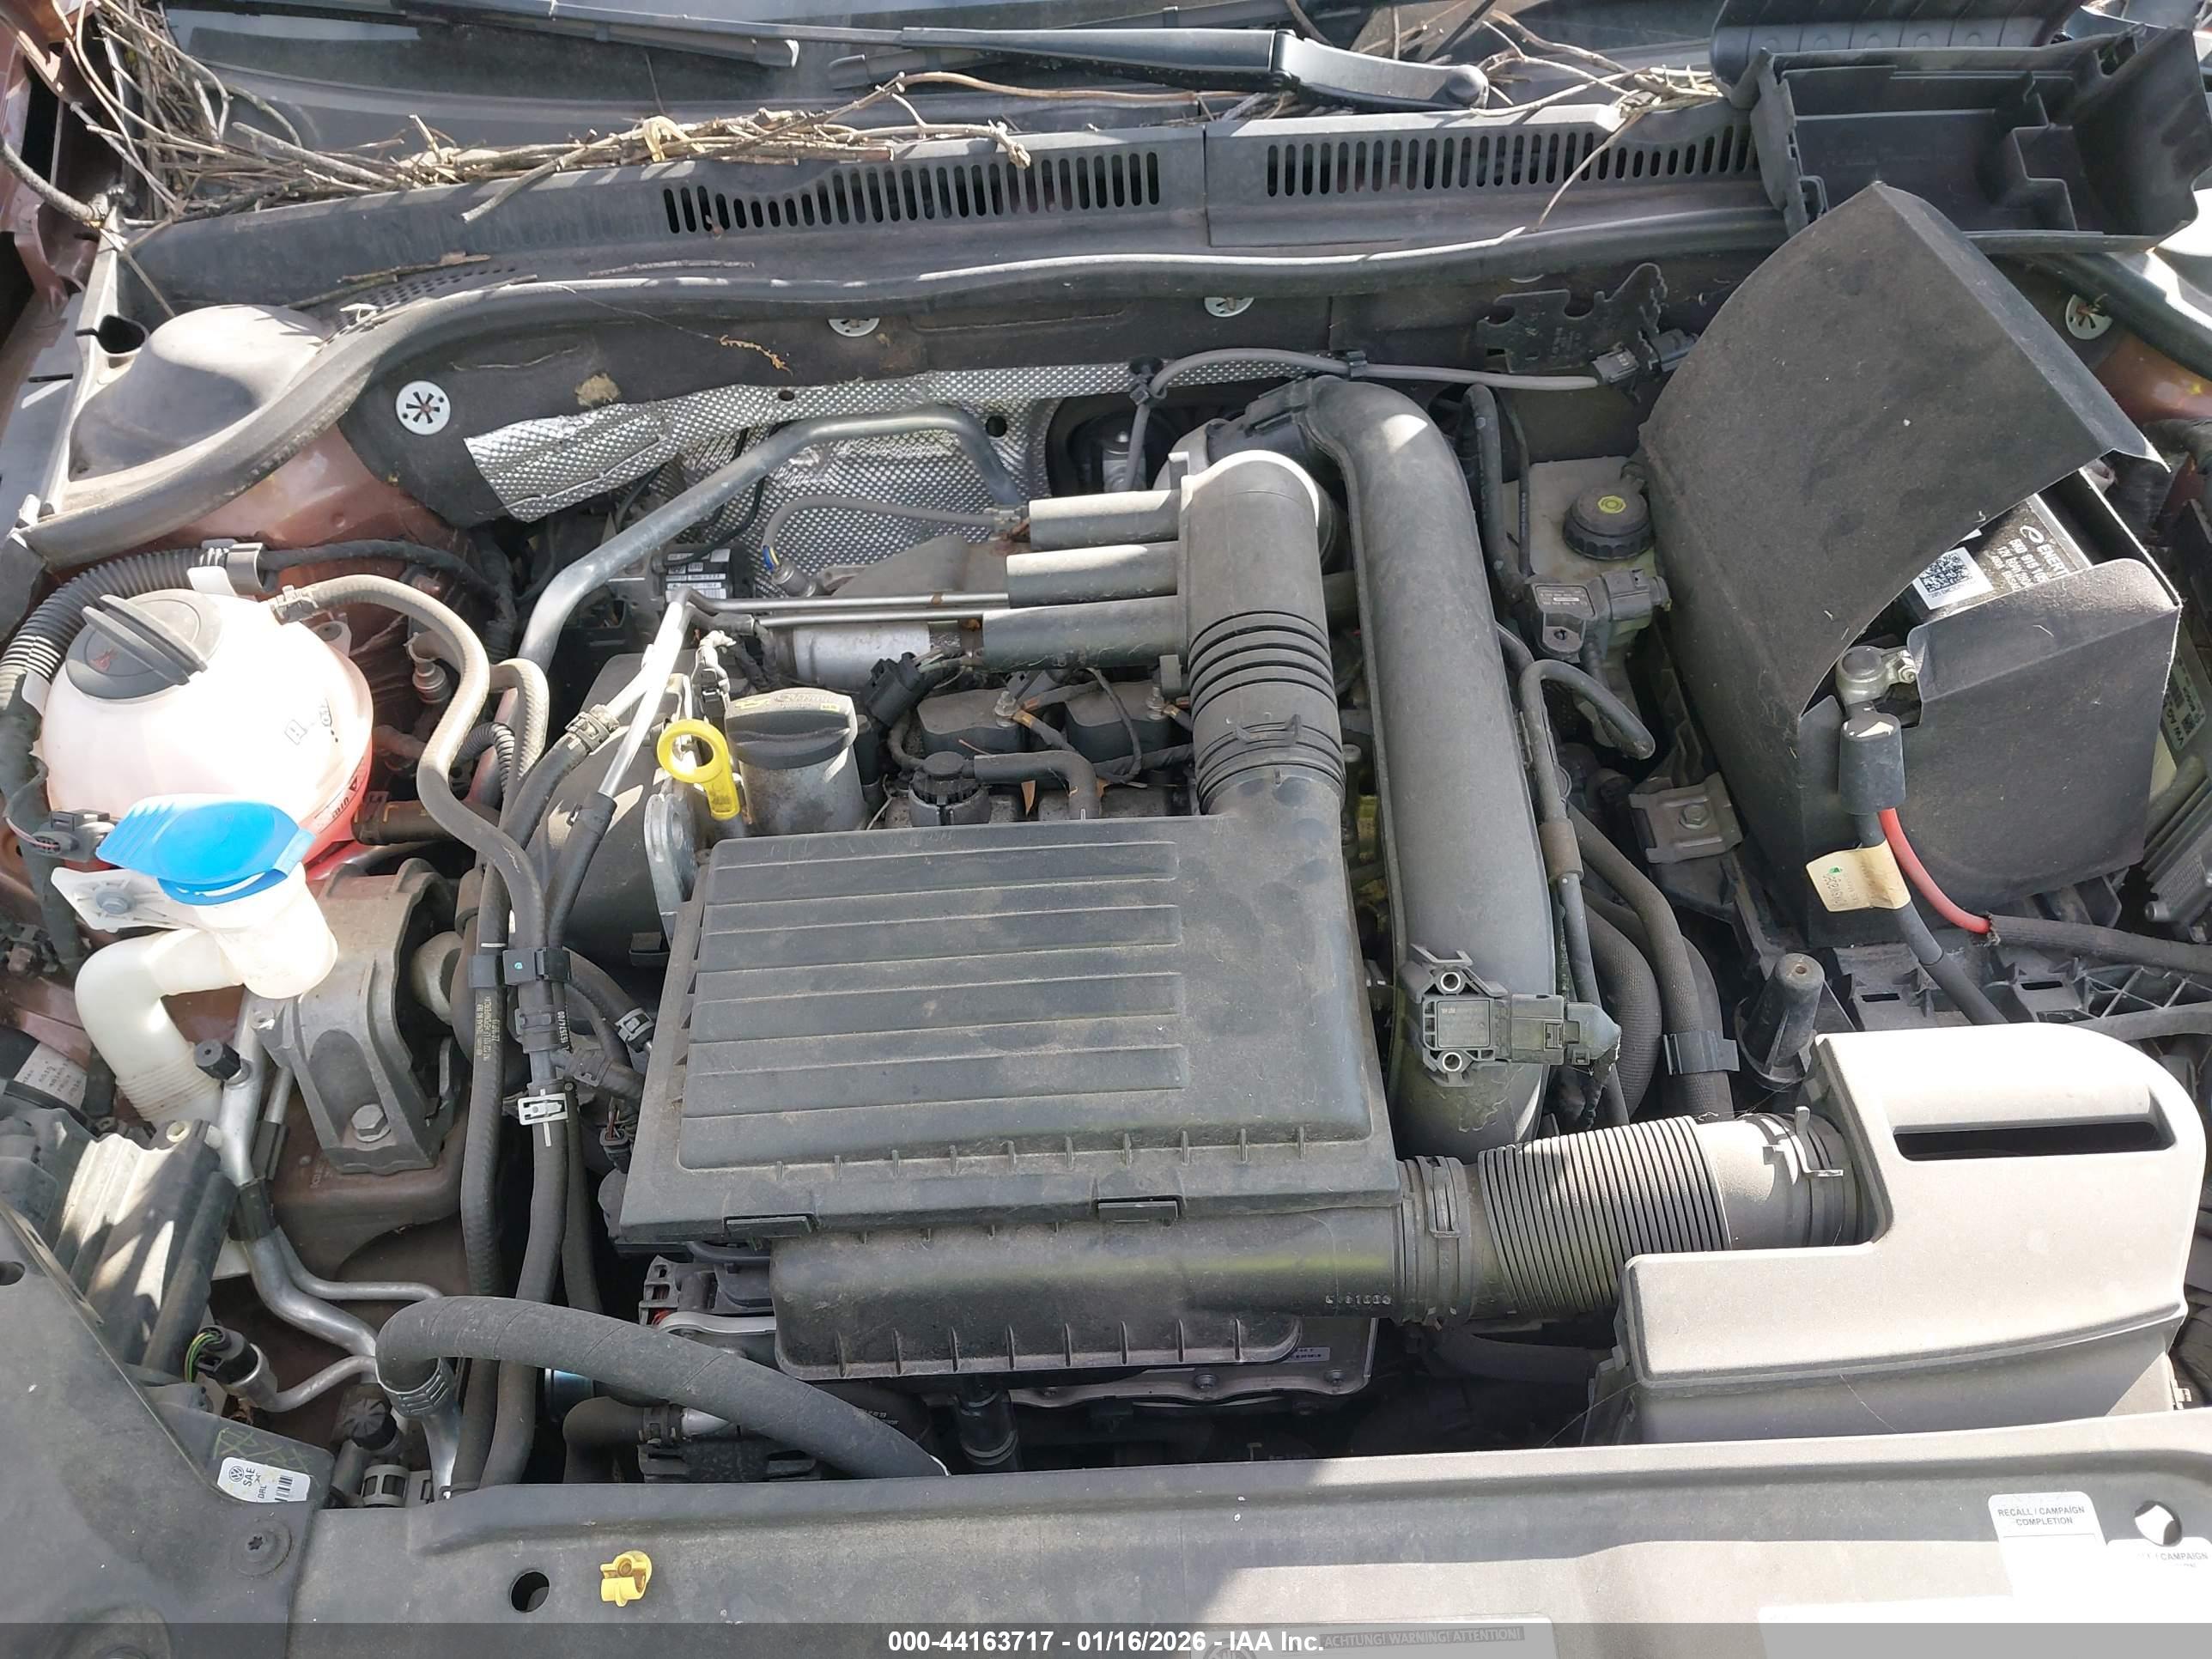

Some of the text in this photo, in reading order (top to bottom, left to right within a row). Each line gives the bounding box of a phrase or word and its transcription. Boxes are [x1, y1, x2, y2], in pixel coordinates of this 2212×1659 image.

[243, 1467, 256, 1486] SAE
[258, 1485, 267, 1498] DRL
[1997, 1507, 2033, 1516] RECALL
[2039, 1506, 2086, 1516] CAMPAIGN
[2016, 1517, 2074, 1526] COMPLETION
[1325, 1628, 1521, 1647] ACHTUNG! WARNING! ATTENTION!
